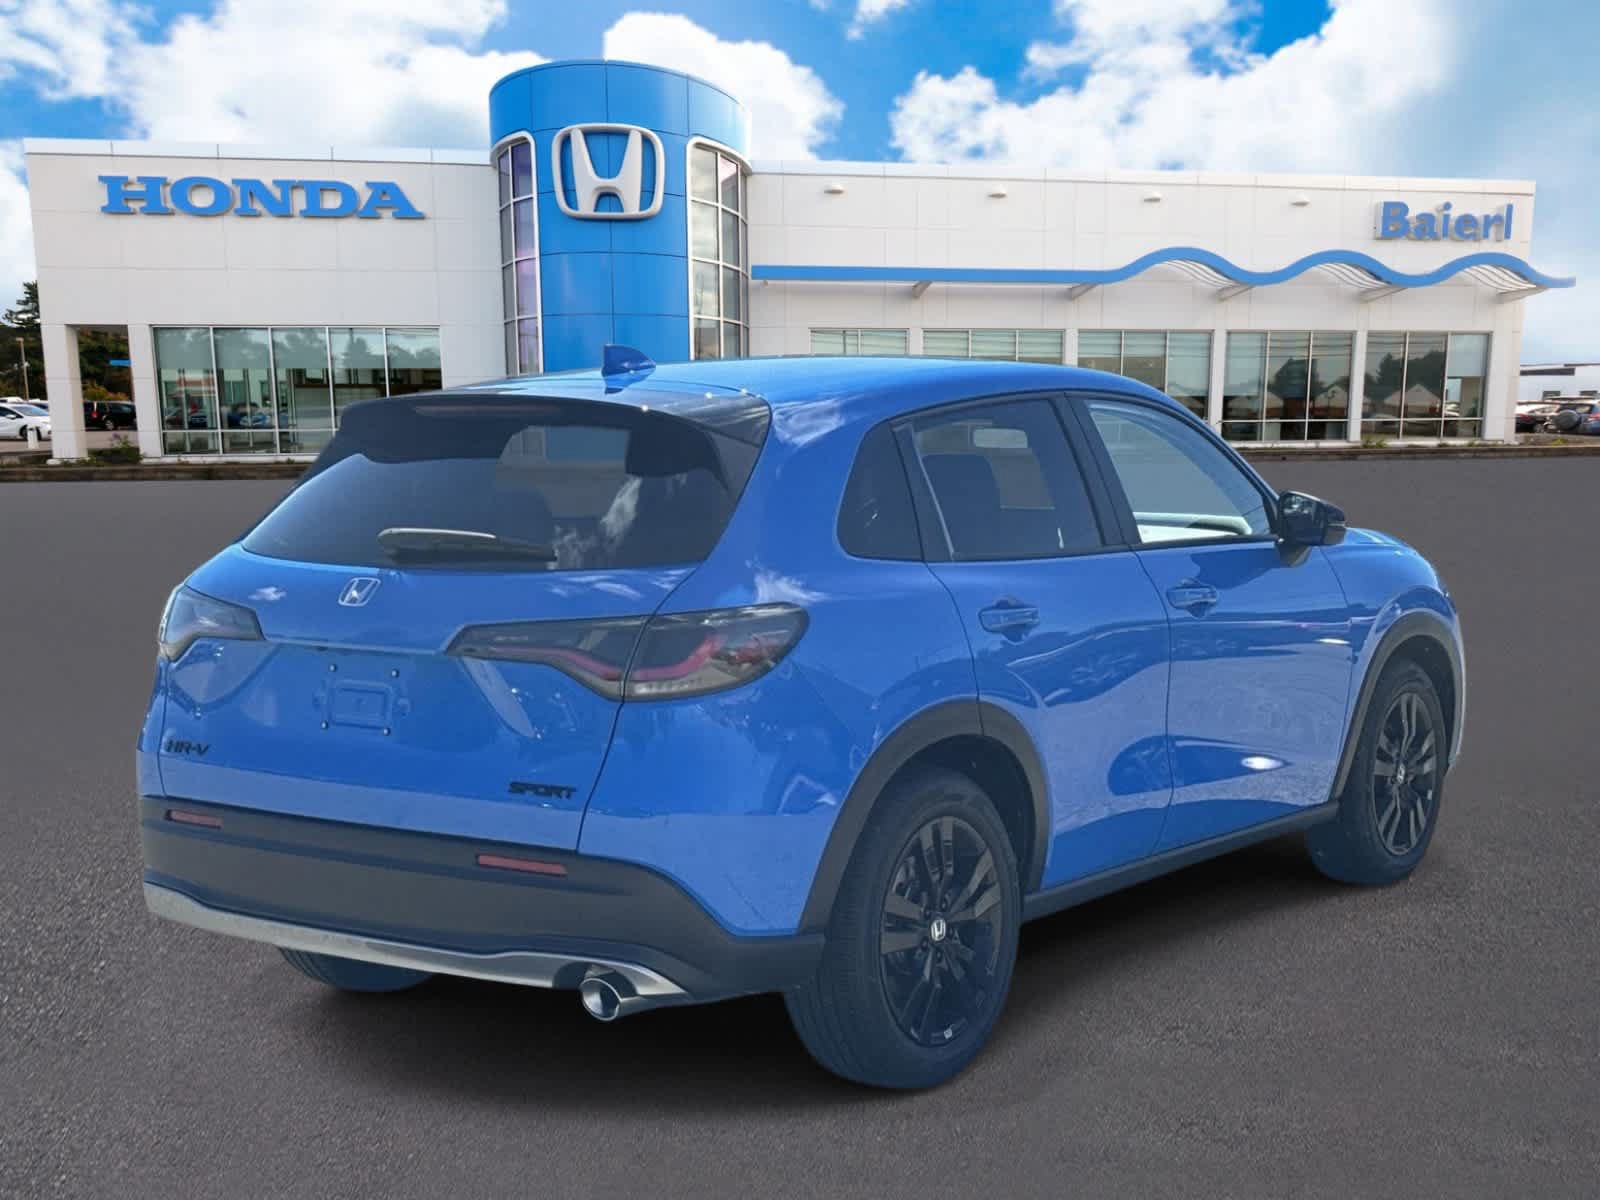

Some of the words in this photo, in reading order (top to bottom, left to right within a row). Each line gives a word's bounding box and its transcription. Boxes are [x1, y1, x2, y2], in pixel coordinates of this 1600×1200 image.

[98, 175, 425, 219] HONDA
[1378, 200, 1514, 241] Baierl
[165, 739, 209, 756] HR-V
[508, 781, 577, 799] SPORT
